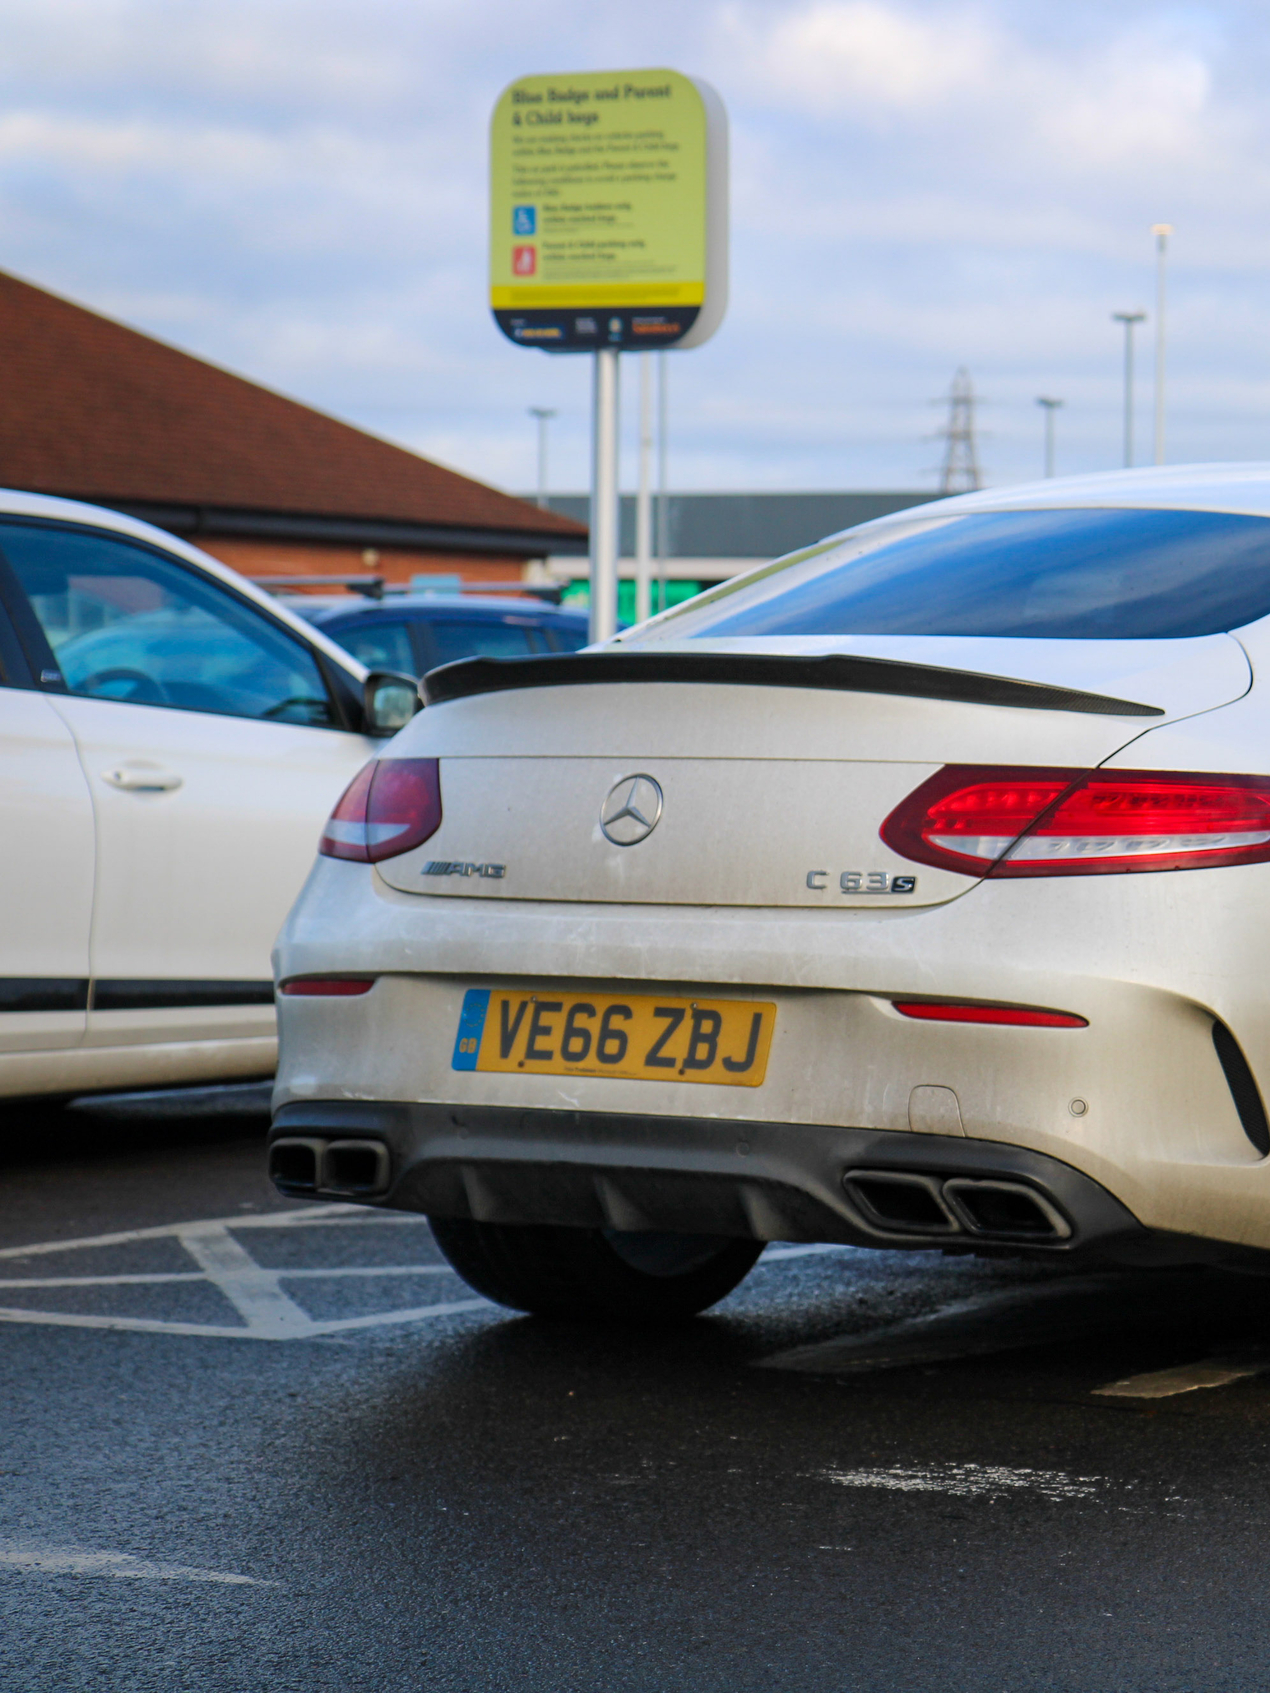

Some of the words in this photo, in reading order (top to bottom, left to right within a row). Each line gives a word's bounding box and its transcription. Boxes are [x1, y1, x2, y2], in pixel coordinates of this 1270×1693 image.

[512, 88, 543, 104] Blue
[547, 86, 589, 105] Badge
[594, 84, 619, 100] and
[624, 83, 671, 99] Parent
[500, 999, 633, 1065] VE66
[644, 1006, 763, 1074] ZBJ
